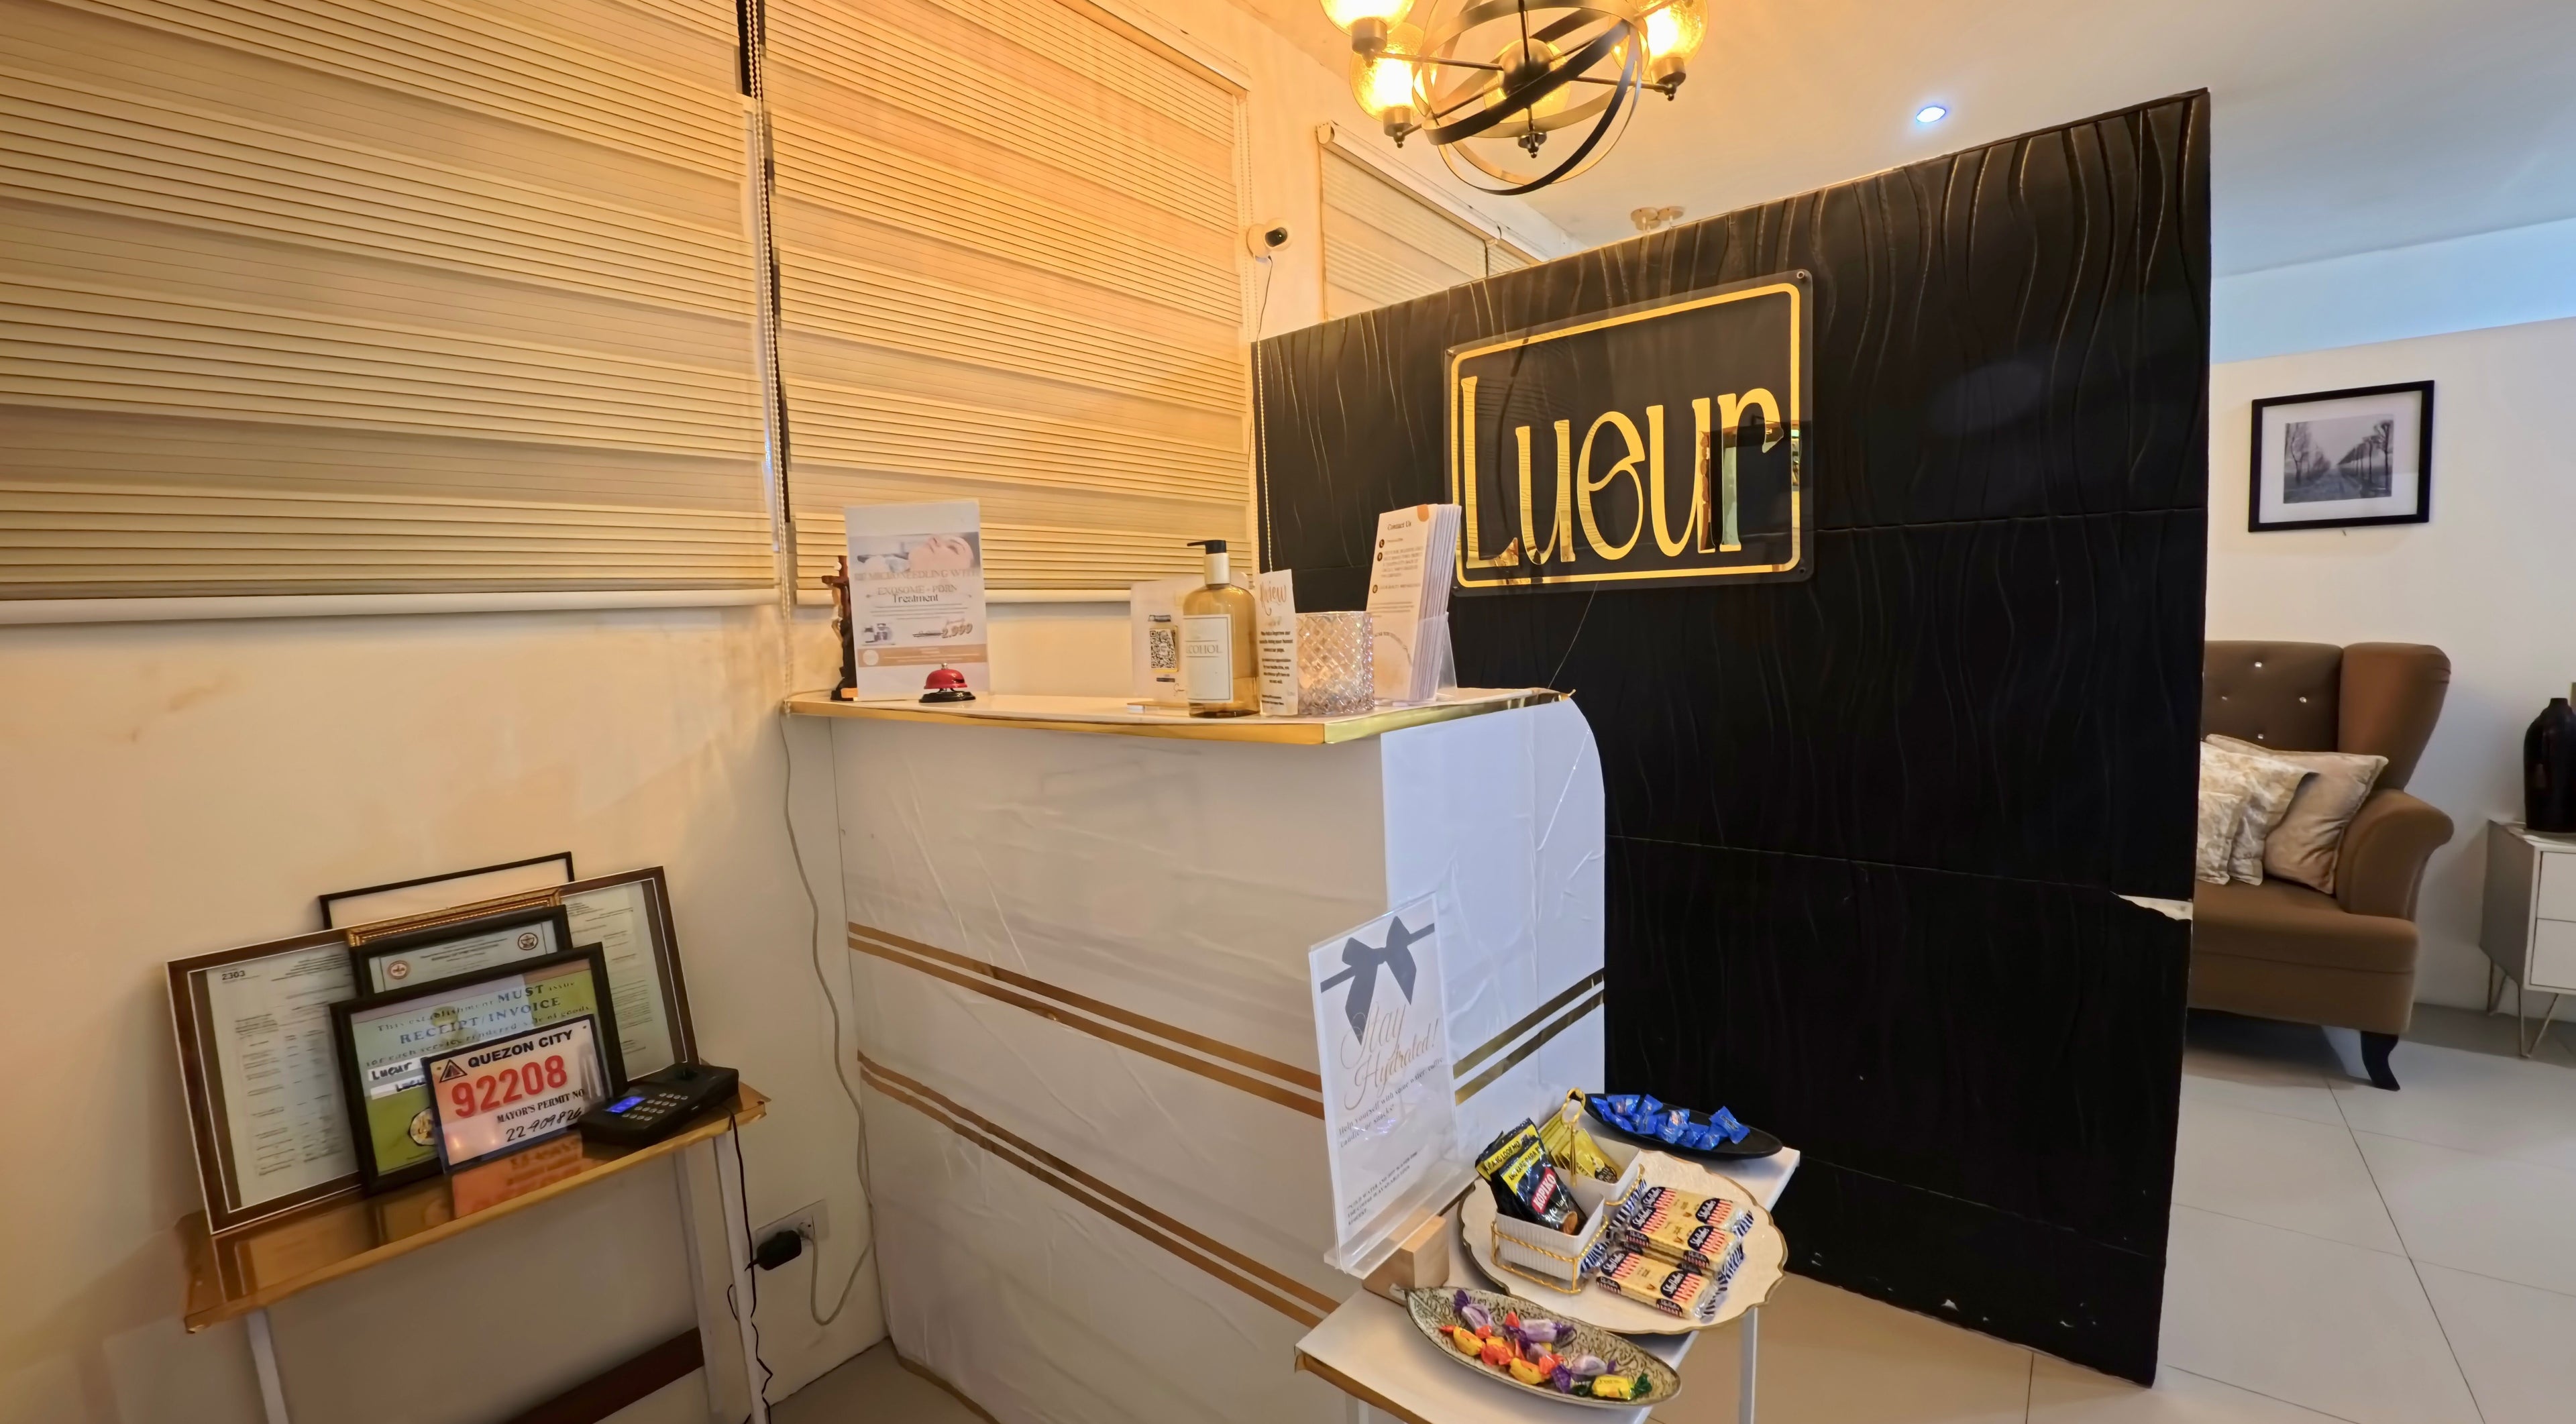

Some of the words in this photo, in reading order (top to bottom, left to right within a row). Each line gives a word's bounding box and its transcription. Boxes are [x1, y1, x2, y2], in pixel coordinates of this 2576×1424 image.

[1460, 376, 1784, 569] Lueur
[893, 594, 938, 603] Treatment
[221, 971, 246, 981] 2303
[498, 985, 545, 1003] MUST
[400, 997, 561, 1044] RECEIPT/INVOICE
[1340, 1001, 1406, 1069] Stay
[468, 1040, 534, 1068] QUEZON
[539, 1030, 572, 1048] CITY
[1344, 1018, 1439, 1111] Hydrated!
[372, 1061, 412, 1080] Lueur
[451, 1054, 568, 1117] 92208
[496, 1105, 535, 1123] MAYOR'S
[537, 1093, 571, 1111] PERMIT
[1338, 1120, 1354, 1136] Help
[1355, 1100, 1381, 1124] yourself
[1381, 1093, 1394, 1105] with
[1501, 1146, 1513, 1160] LOOB
[1512, 1141, 1521, 1150] MO
[1533, 1174, 1556, 1211] KOPIKO
